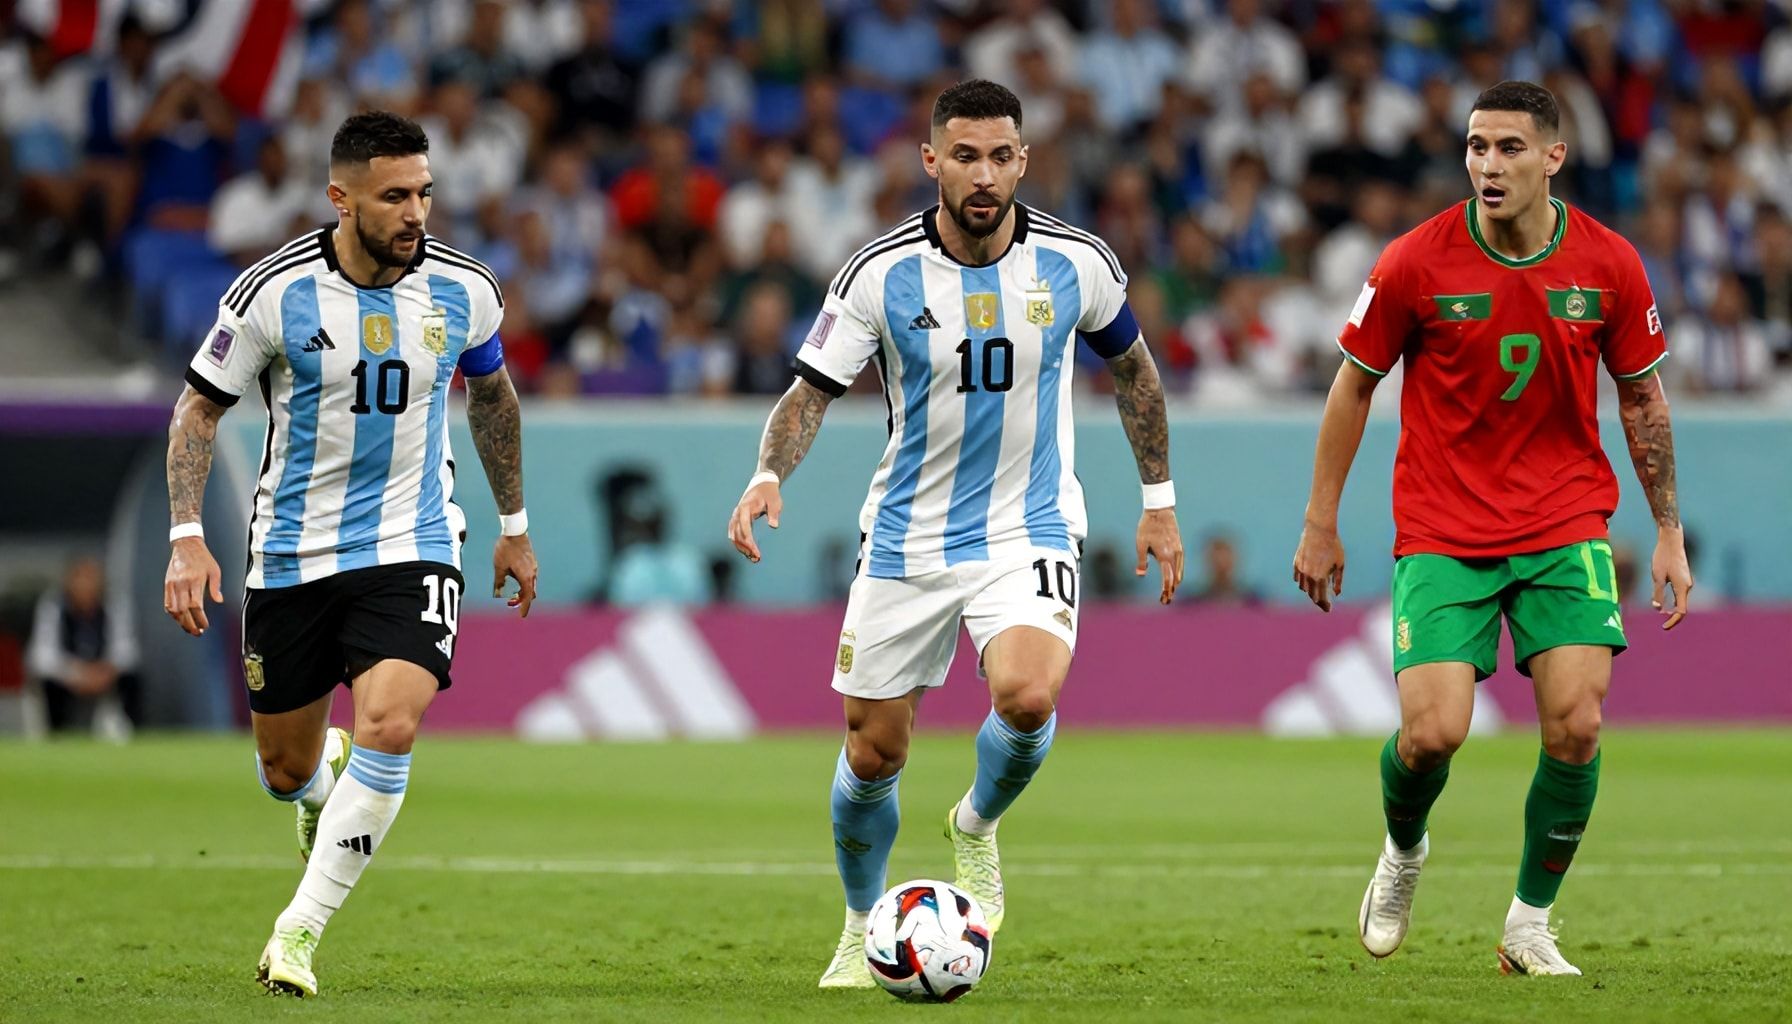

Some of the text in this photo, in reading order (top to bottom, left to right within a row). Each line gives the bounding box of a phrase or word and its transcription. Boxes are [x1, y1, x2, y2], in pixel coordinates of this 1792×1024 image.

[350, 359, 410, 415] 10
[956, 337, 1014, 392] 10
[1499, 333, 1541, 401] 9
[421, 574, 460, 636] 10
[1032, 557, 1076, 609] 10
